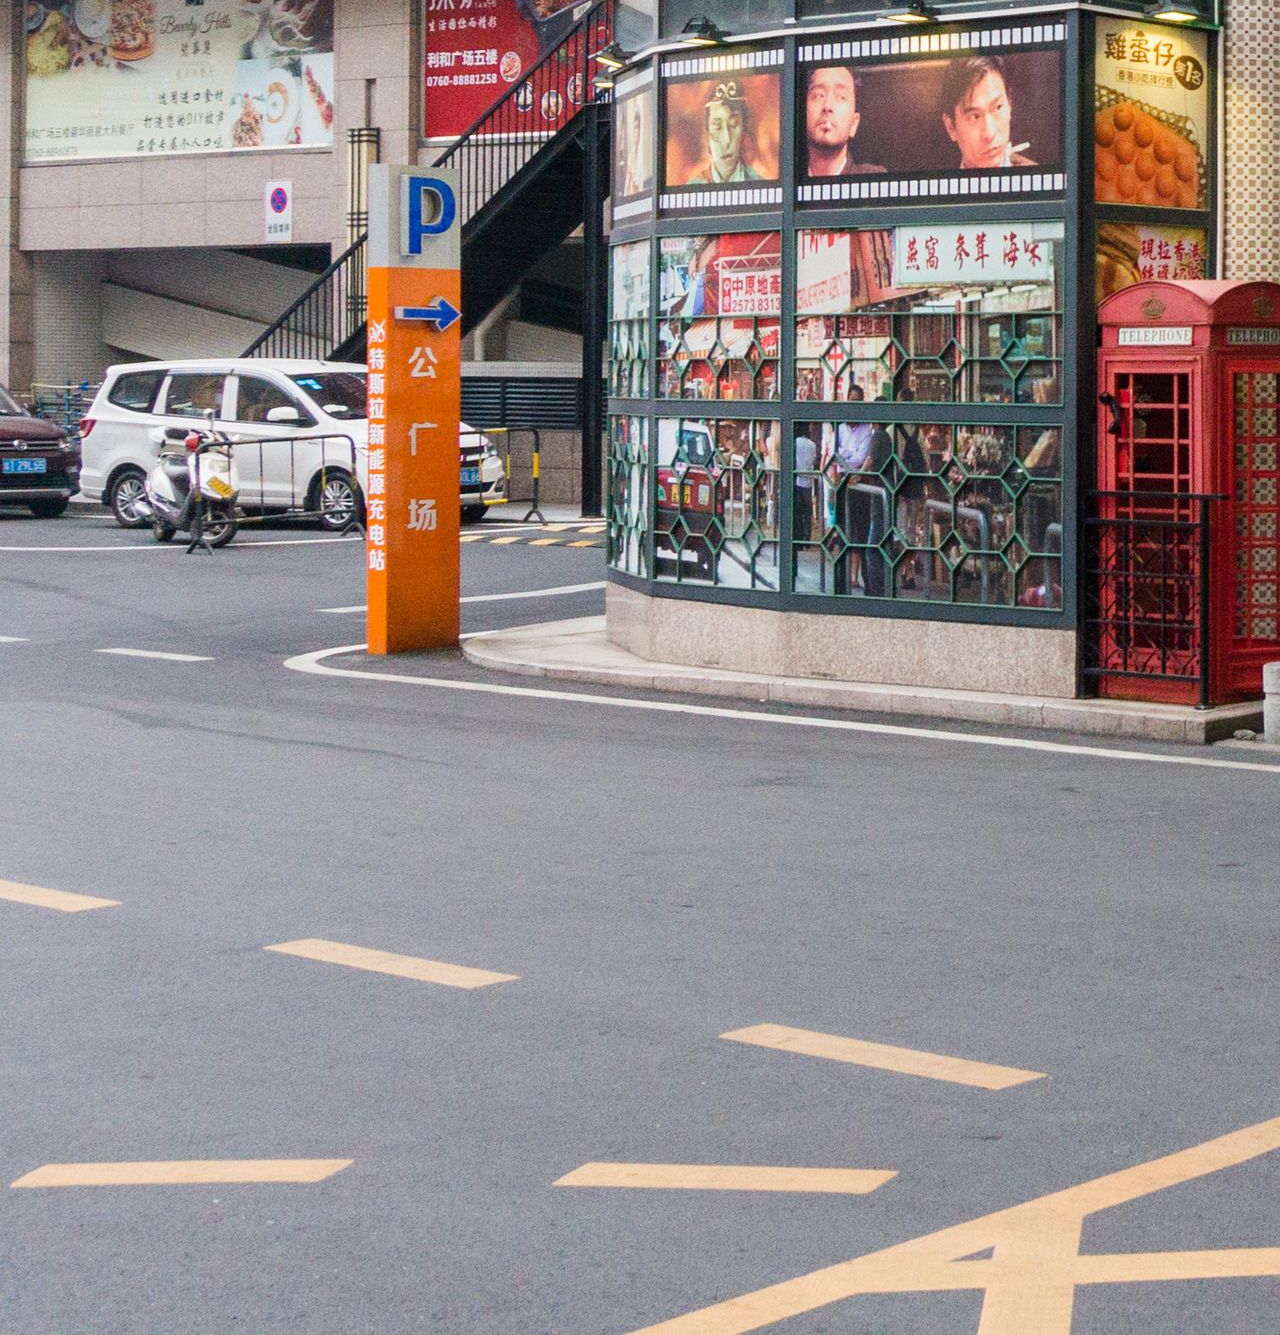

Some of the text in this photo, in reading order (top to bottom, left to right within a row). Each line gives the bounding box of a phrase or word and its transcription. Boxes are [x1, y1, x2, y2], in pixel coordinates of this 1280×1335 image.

[428, 17, 497, 32] 生活因你而精彩
[427, 49, 498, 68] 利和广场五楼
[427, 73, 498, 87] 0760-88881258
[401, 175, 456, 255] P
[1003, 231, 1042, 270] 海味
[1141, 238, 1204, 262] 現拉香港
[732, 275, 781, 297] 中原地產
[732, 298, 781, 311] 2573 8313
[1121, 328, 1191, 343] TELEPHONE
[367, 348, 386, 571] 特斯拉新能源充电站
